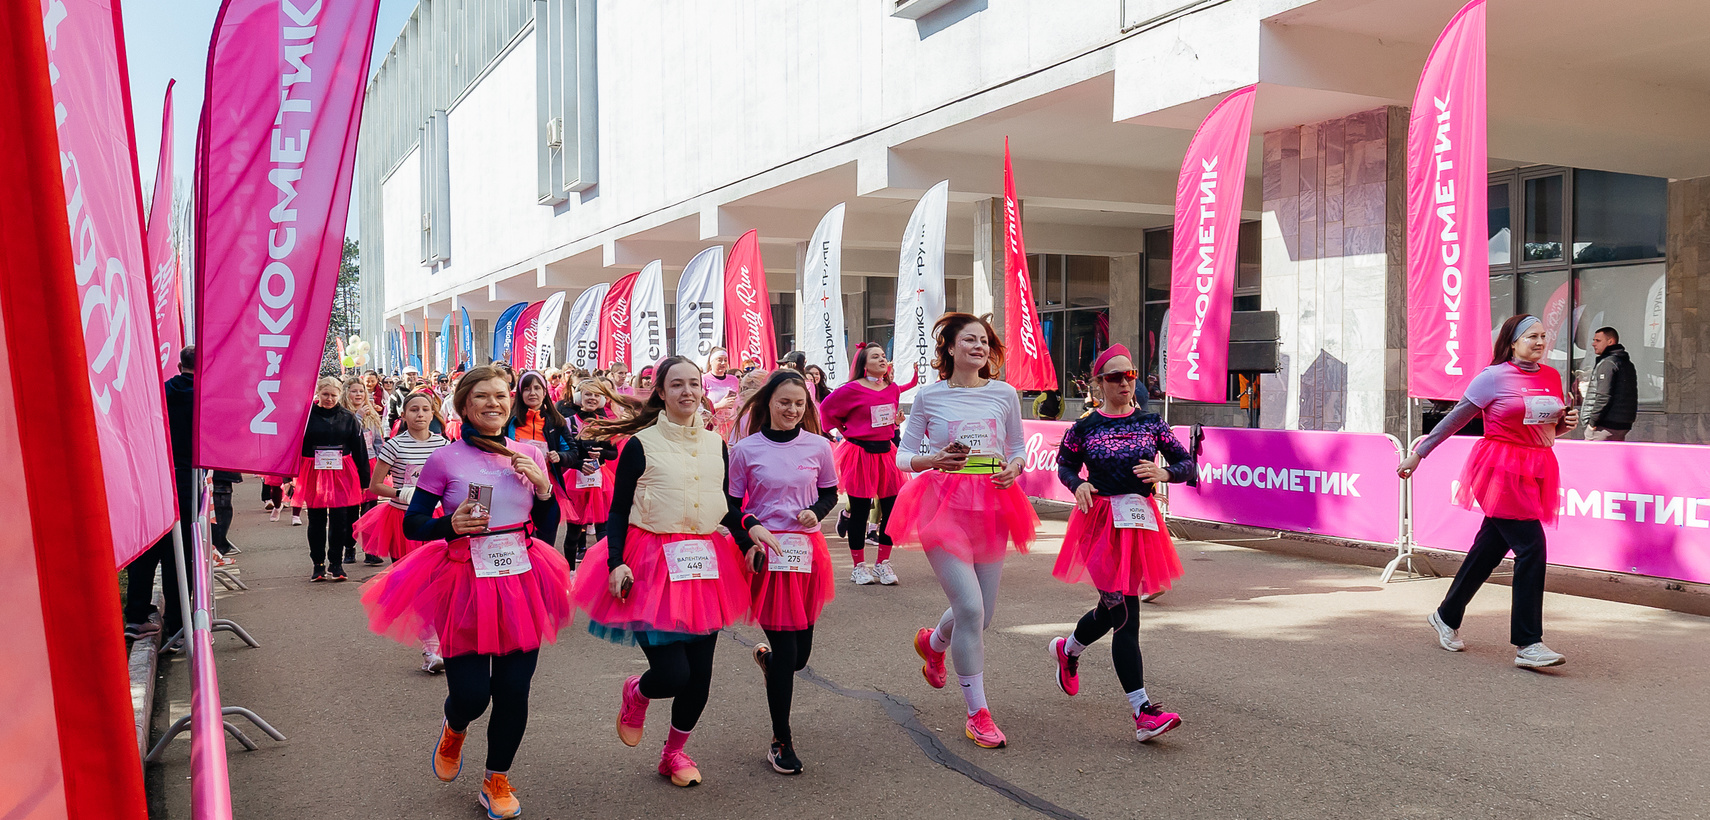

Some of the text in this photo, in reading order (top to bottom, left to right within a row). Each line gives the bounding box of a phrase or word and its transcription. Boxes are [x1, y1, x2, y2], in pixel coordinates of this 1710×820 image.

[736, 265, 756, 307] Run
[611, 297, 629, 328] Run
[524, 318, 538, 343] Run
[641, 311, 660, 361] emi
[689, 302, 714, 356] emi
[576, 340, 587, 369] een
[823, 312, 836, 380] аффикс
[1024, 433, 1058, 473] Bea
[1131, 512, 1146, 520] 566
[488, 551, 515, 559] ТАТЬЯНА
[493, 557, 513, 567] 820
[687, 562, 703, 570] 449
[787, 555, 801, 563] 275
